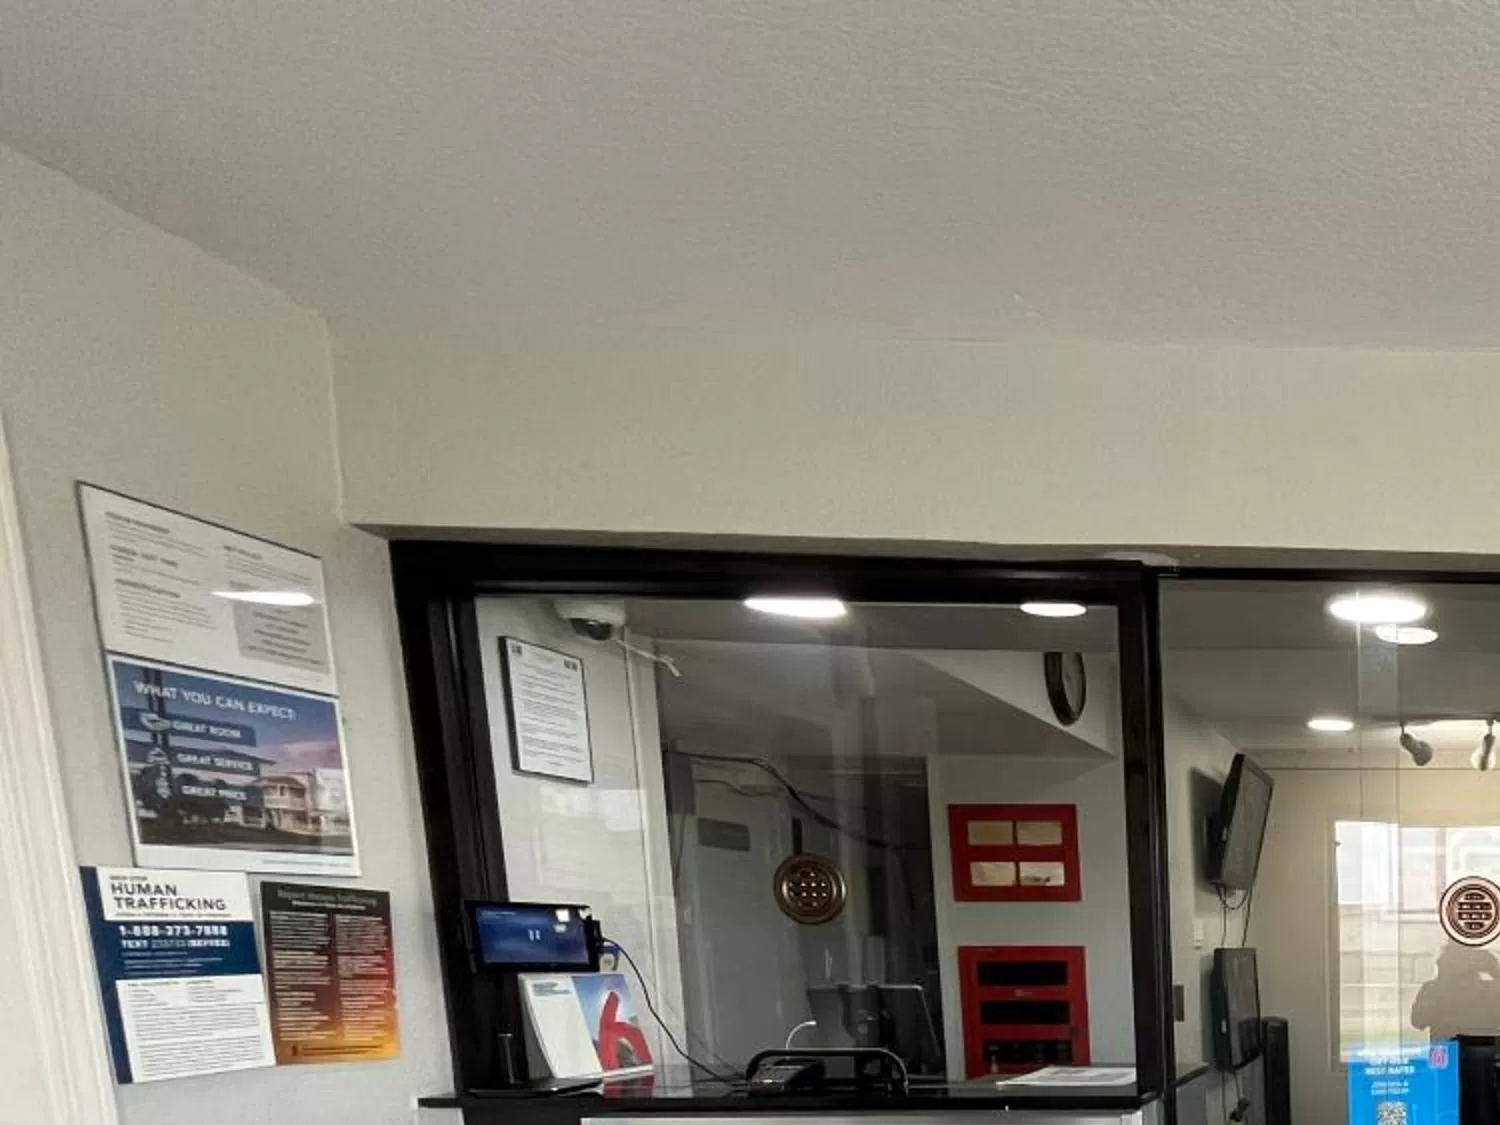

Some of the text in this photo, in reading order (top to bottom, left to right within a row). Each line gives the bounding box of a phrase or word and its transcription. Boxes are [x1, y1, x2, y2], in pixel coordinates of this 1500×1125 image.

[134, 680, 177, 701] WHAT
[182, 688, 211, 705] YOU
[111, 883, 178, 896] HUMAN
[113, 897, 228, 911] TRAFFICKING
